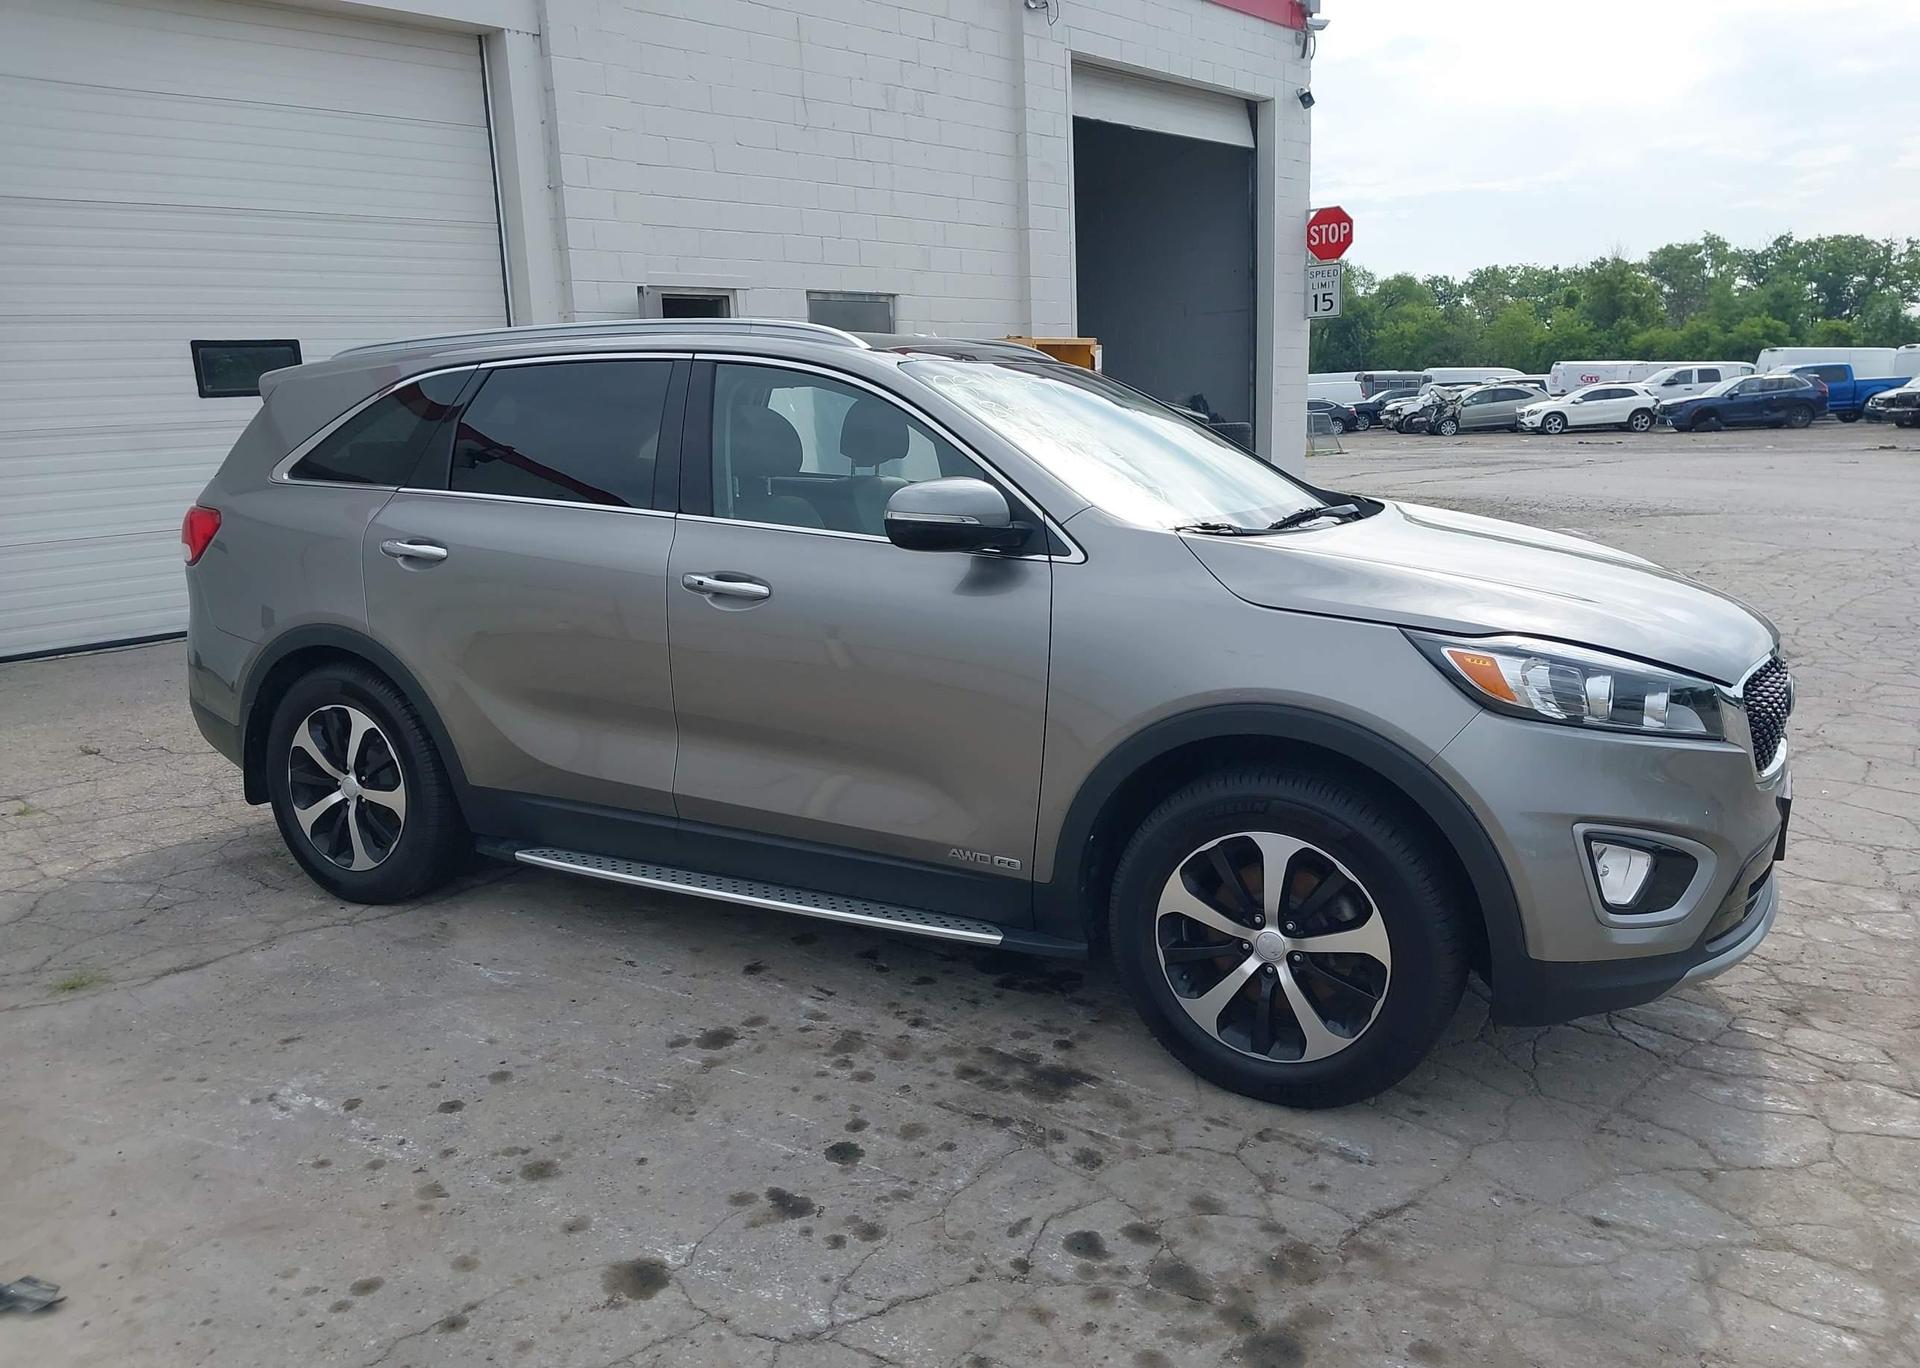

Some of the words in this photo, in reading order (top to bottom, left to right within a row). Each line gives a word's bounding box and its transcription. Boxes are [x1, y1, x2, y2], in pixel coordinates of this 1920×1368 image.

[1309, 222, 1350, 246] STOP
[1309, 269, 1339, 280] SPEED
[1311, 281, 1336, 290] LIMIT
[1312, 292, 1334, 313] 15
[948, 848, 992, 865] AWD
